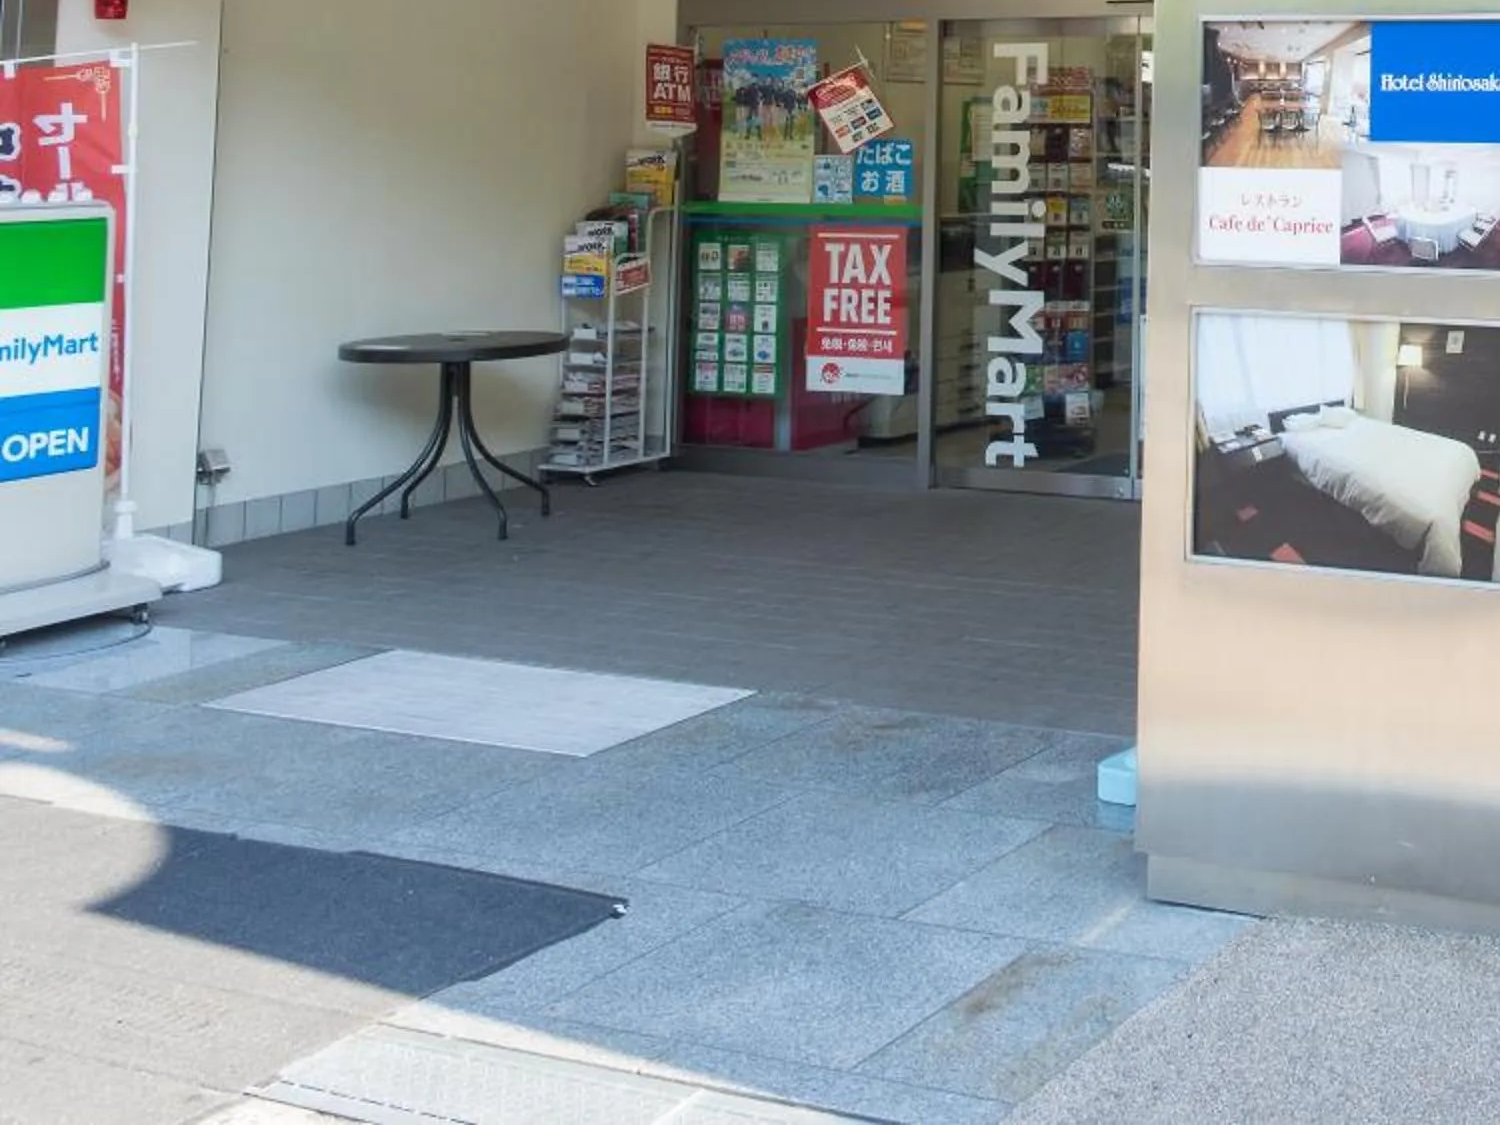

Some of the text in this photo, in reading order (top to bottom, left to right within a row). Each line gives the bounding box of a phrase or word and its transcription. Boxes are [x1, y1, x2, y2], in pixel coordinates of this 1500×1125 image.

[653, 62, 689, 84] 銀行
[1380, 73, 1424, 92] Hotel
[653, 82, 691, 102] ATM
[856, 143, 912, 165] たばこ
[860, 169, 906, 194] お酒
[1241, 193, 1302, 209] レストラン
[1208, 215, 1242, 230] Cafe
[1273, 216, 1333, 235] Caprice
[824, 242, 892, 286] TAX
[974, 43, 1048, 467] FamilyMart
[823, 288, 893, 325] FREE
[2, 426, 89, 463] OPEN
